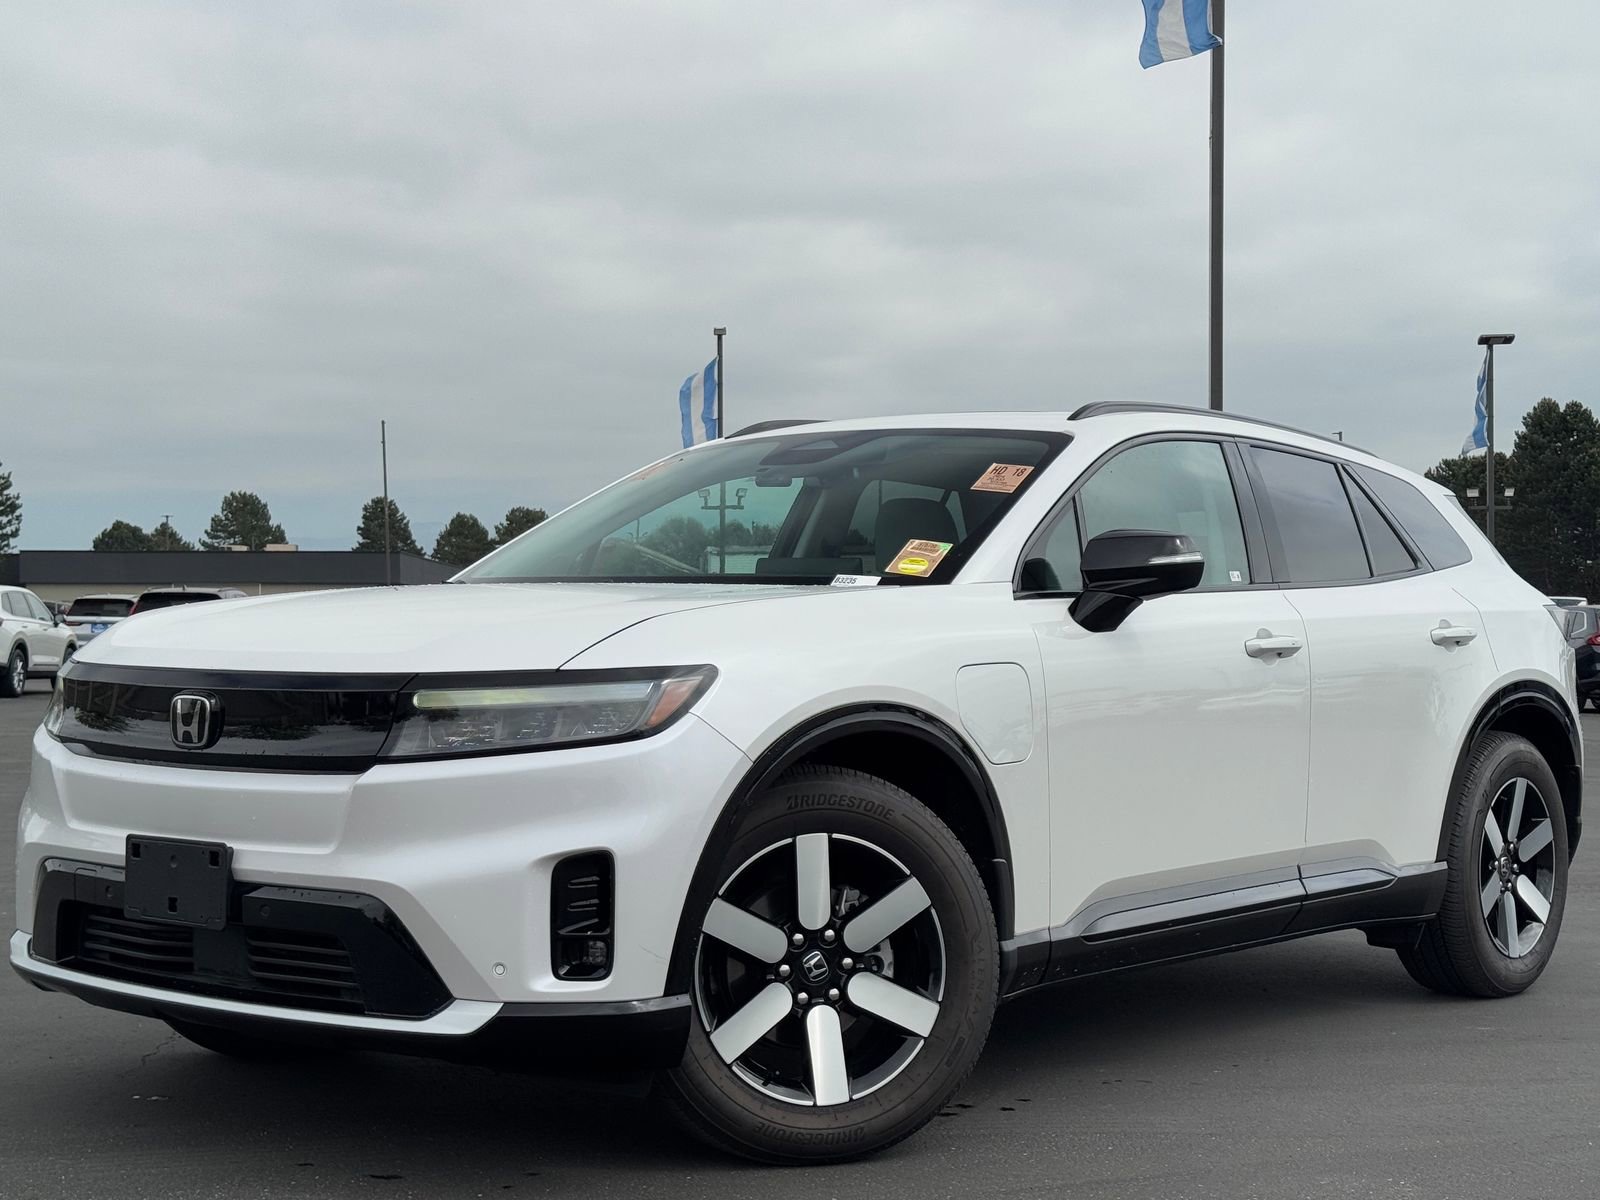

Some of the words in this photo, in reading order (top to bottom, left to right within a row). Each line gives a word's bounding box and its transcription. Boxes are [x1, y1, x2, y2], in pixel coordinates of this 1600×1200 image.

[990, 465, 1008, 475] HD
[1012, 467, 1027, 477] 18
[786, 793, 895, 820] BRIDGESTONE
